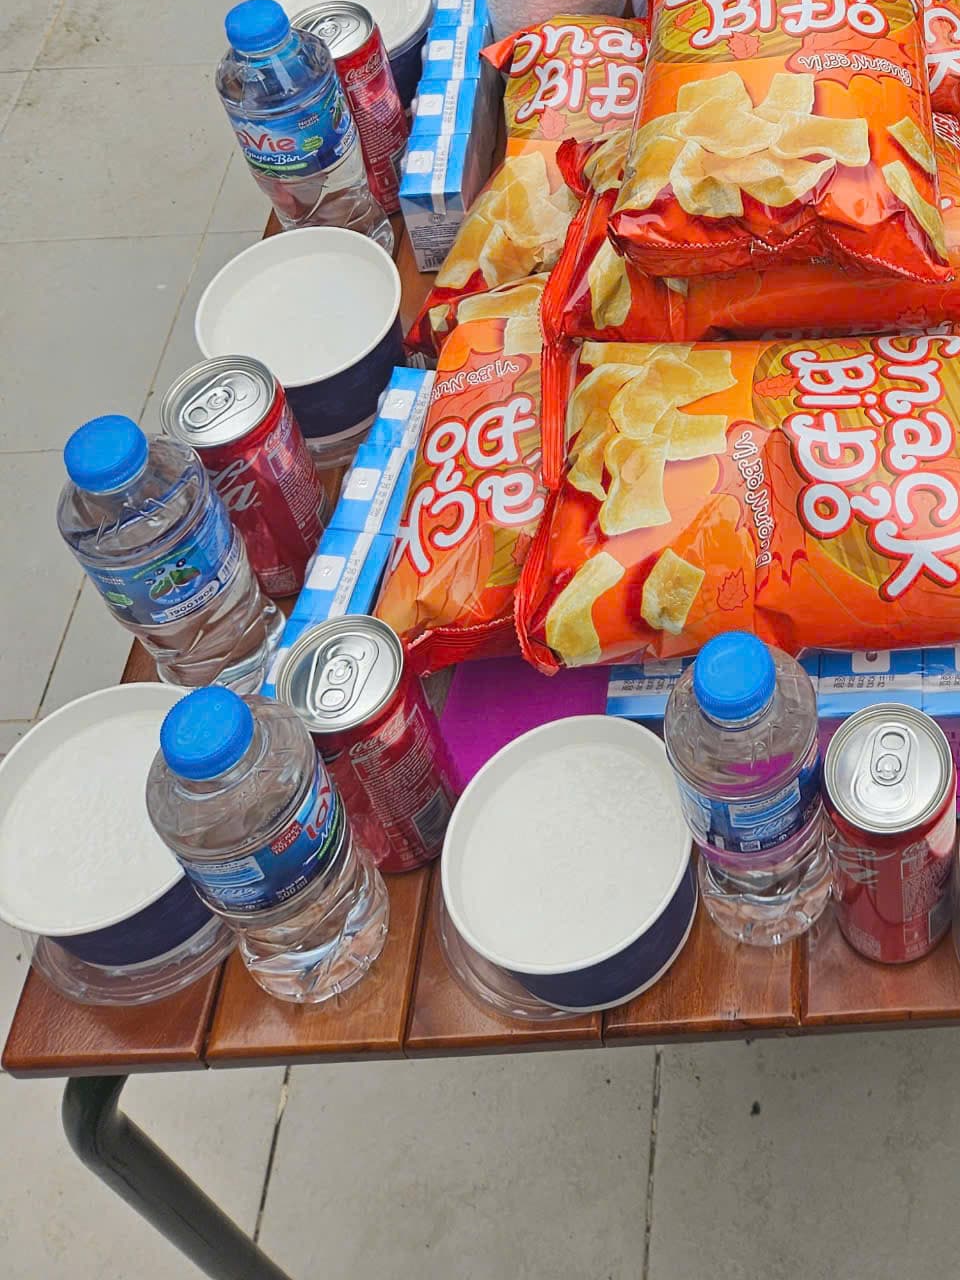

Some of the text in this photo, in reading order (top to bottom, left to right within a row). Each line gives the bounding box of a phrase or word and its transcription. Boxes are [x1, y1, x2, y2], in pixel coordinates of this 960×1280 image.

[516, 58, 602, 121] Bí
[798, 53, 912, 87] Vị Bò Nướng
[467, 366, 494, 384] Bò
[495, 360, 519, 380] Vị
[426, 396, 536, 491] Đỏ
[789, 352, 892, 535] Bí Đỏ
[731, 431, 777, 568] Vị Bò Nướng
